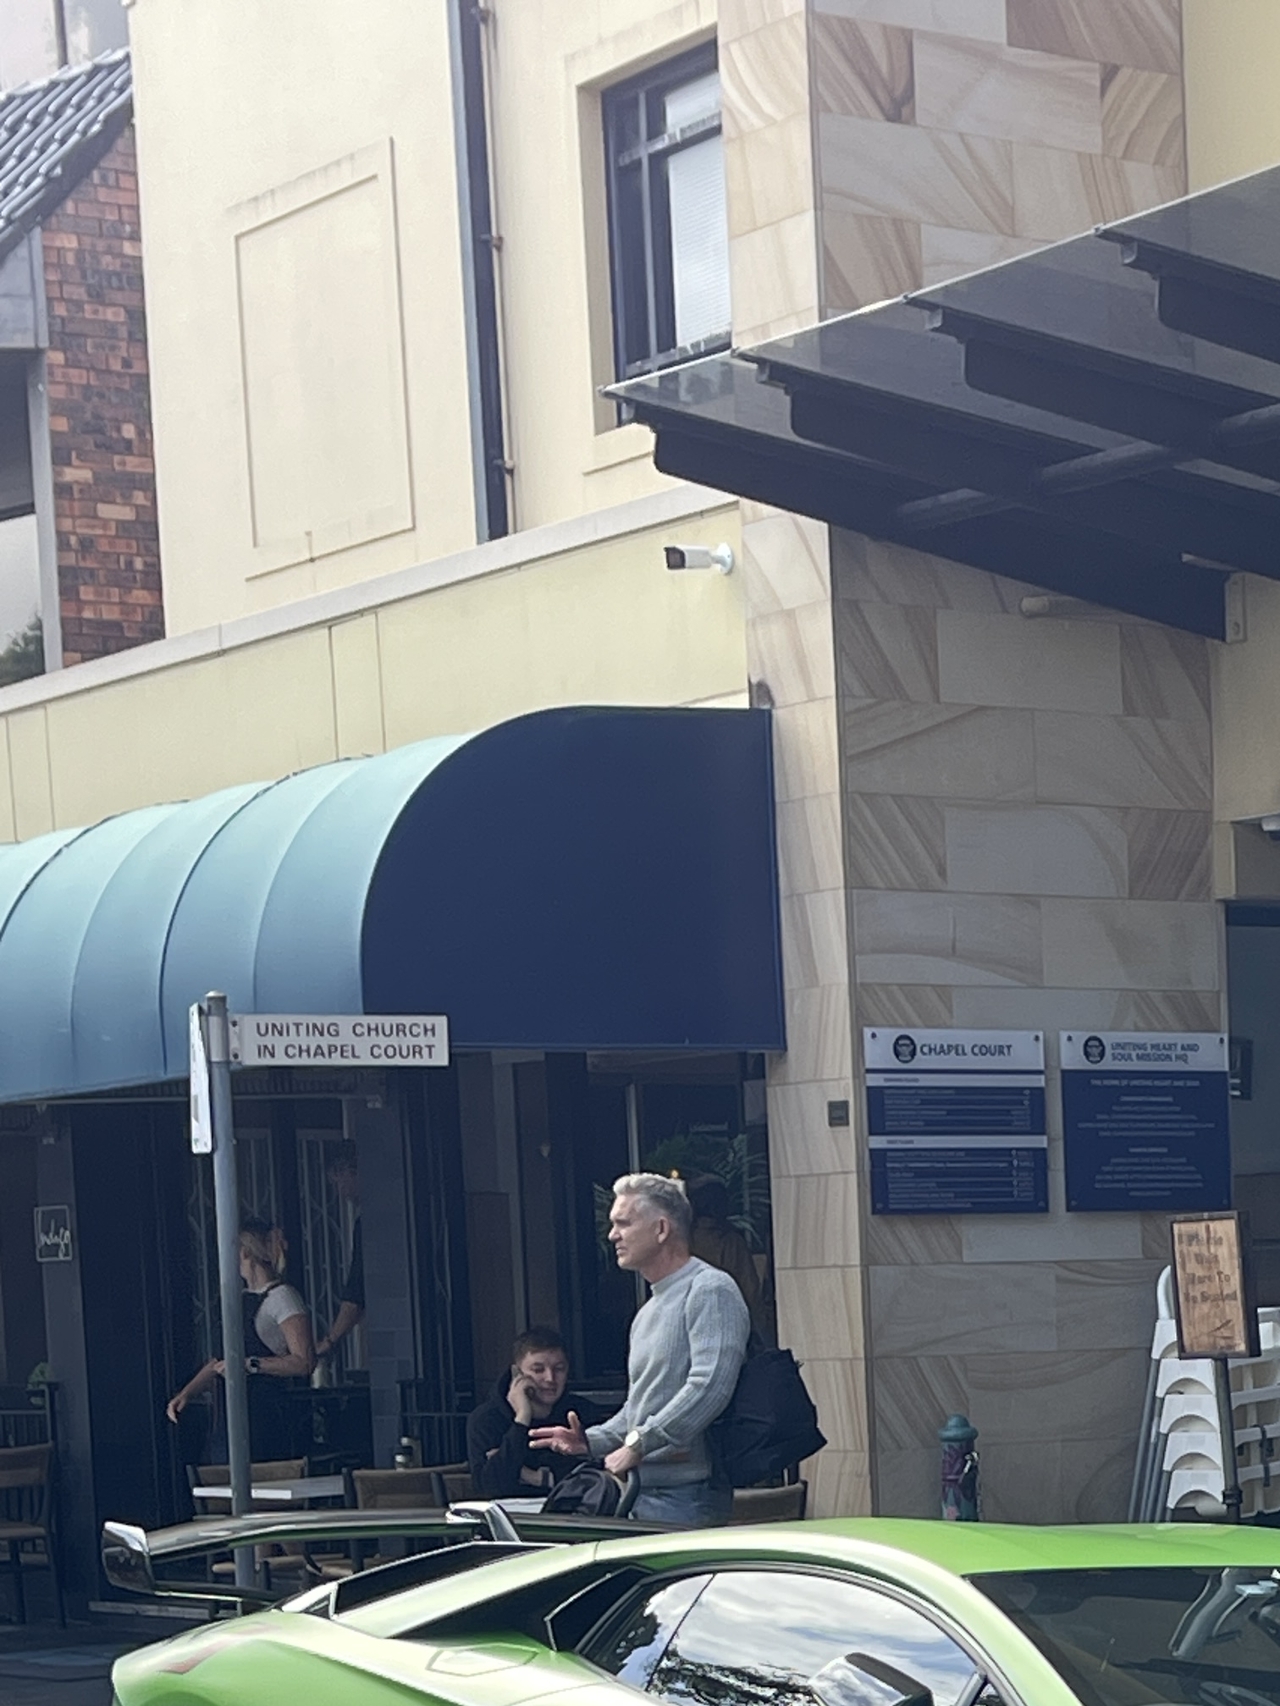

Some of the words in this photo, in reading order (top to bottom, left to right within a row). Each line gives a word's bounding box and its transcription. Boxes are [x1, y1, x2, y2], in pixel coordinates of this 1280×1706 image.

[256, 1022, 340, 1037] UNITING
[352, 1022, 436, 1037] CHURCH
[257, 1044, 276, 1059] IN
[284, 1044, 361, 1059] CHAPEL
[369, 1044, 436, 1059] COURT
[919, 1043, 968, 1057] CHAPEL
[970, 1043, 1013, 1057] COURT
[1111, 1042, 1148, 1051] UNITING
[1150, 1042, 1178, 1052] HEART
[1180, 1042, 1200, 1053] AND
[1111, 1052, 1134, 1062] SOUL
[1136, 1053, 1173, 1063] MISSION
[1174, 1053, 1189, 1064] HQ
